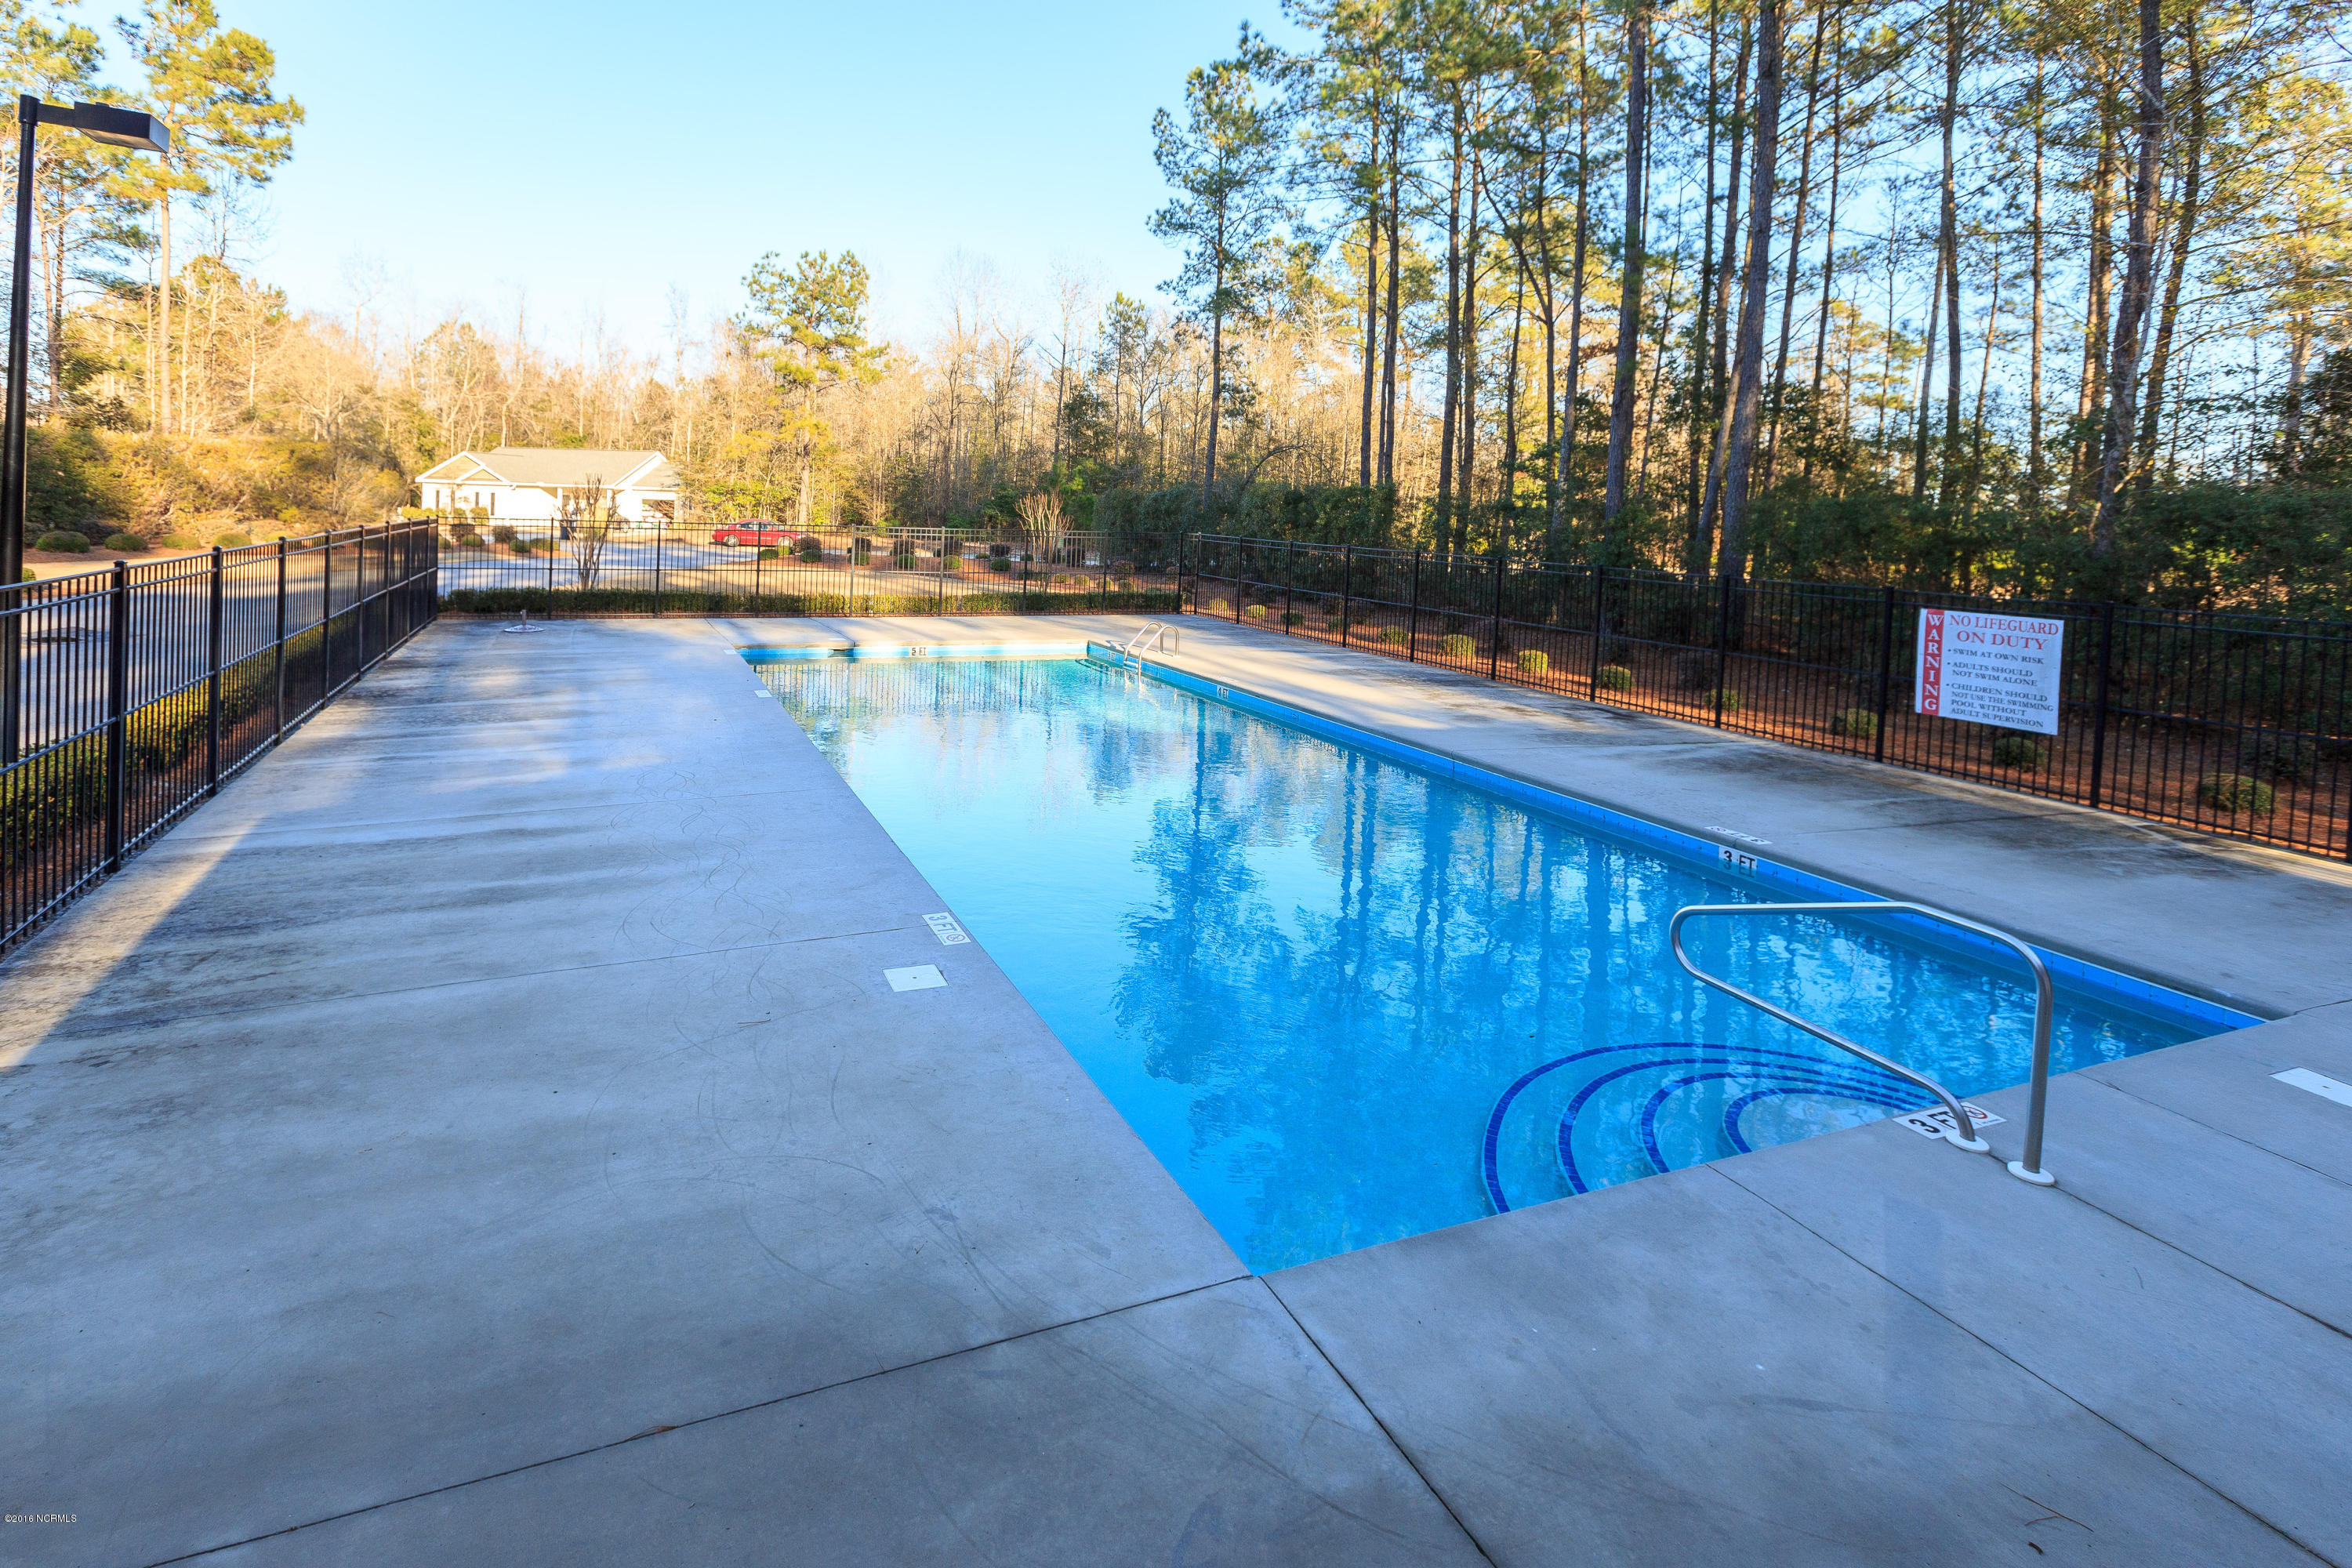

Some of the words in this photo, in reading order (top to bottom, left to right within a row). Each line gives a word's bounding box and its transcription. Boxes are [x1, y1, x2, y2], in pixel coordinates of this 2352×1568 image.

[1950, 615, 1971, 626] NO
[1975, 616, 2059, 635] LIFEGUARD
[1957, 630, 1985, 644] ON
[1991, 633, 2048, 650] DUTY
[1925, 614, 1944, 710] WARNING
[1953, 648, 1977, 657] SWIM
[1994, 652, 2019, 662] OWN
[2021, 655, 2044, 665] RISK
[1951, 662, 1989, 671] ADULTS
[1991, 666, 2033, 677] SHOULD
[1952, 669, 1975, 677] NOT
[1976, 672, 2000, 681] SWIM
[2002, 677, 2038, 687] ALONE
[1951, 682, 2002, 695] CHILDREN
[2005, 690, 2048, 702] SHOULD
[1951, 691, 1970, 699] NOT
[1971, 693, 1986, 702] USE
[1988, 695, 2005, 705] THE
[2007, 699, 2054, 712] SWIMMING
[1951, 699, 1977, 708] POOL
[1979, 703, 2027, 716] WITHOUT
[1951, 707, 1980, 717] ADULT
[1982, 712, 2044, 728] SUPERVISION
[1724, 851, 1733, 862] 3
[933, 922, 957, 931] FT
[1908, 1118, 1940, 1134] 3
